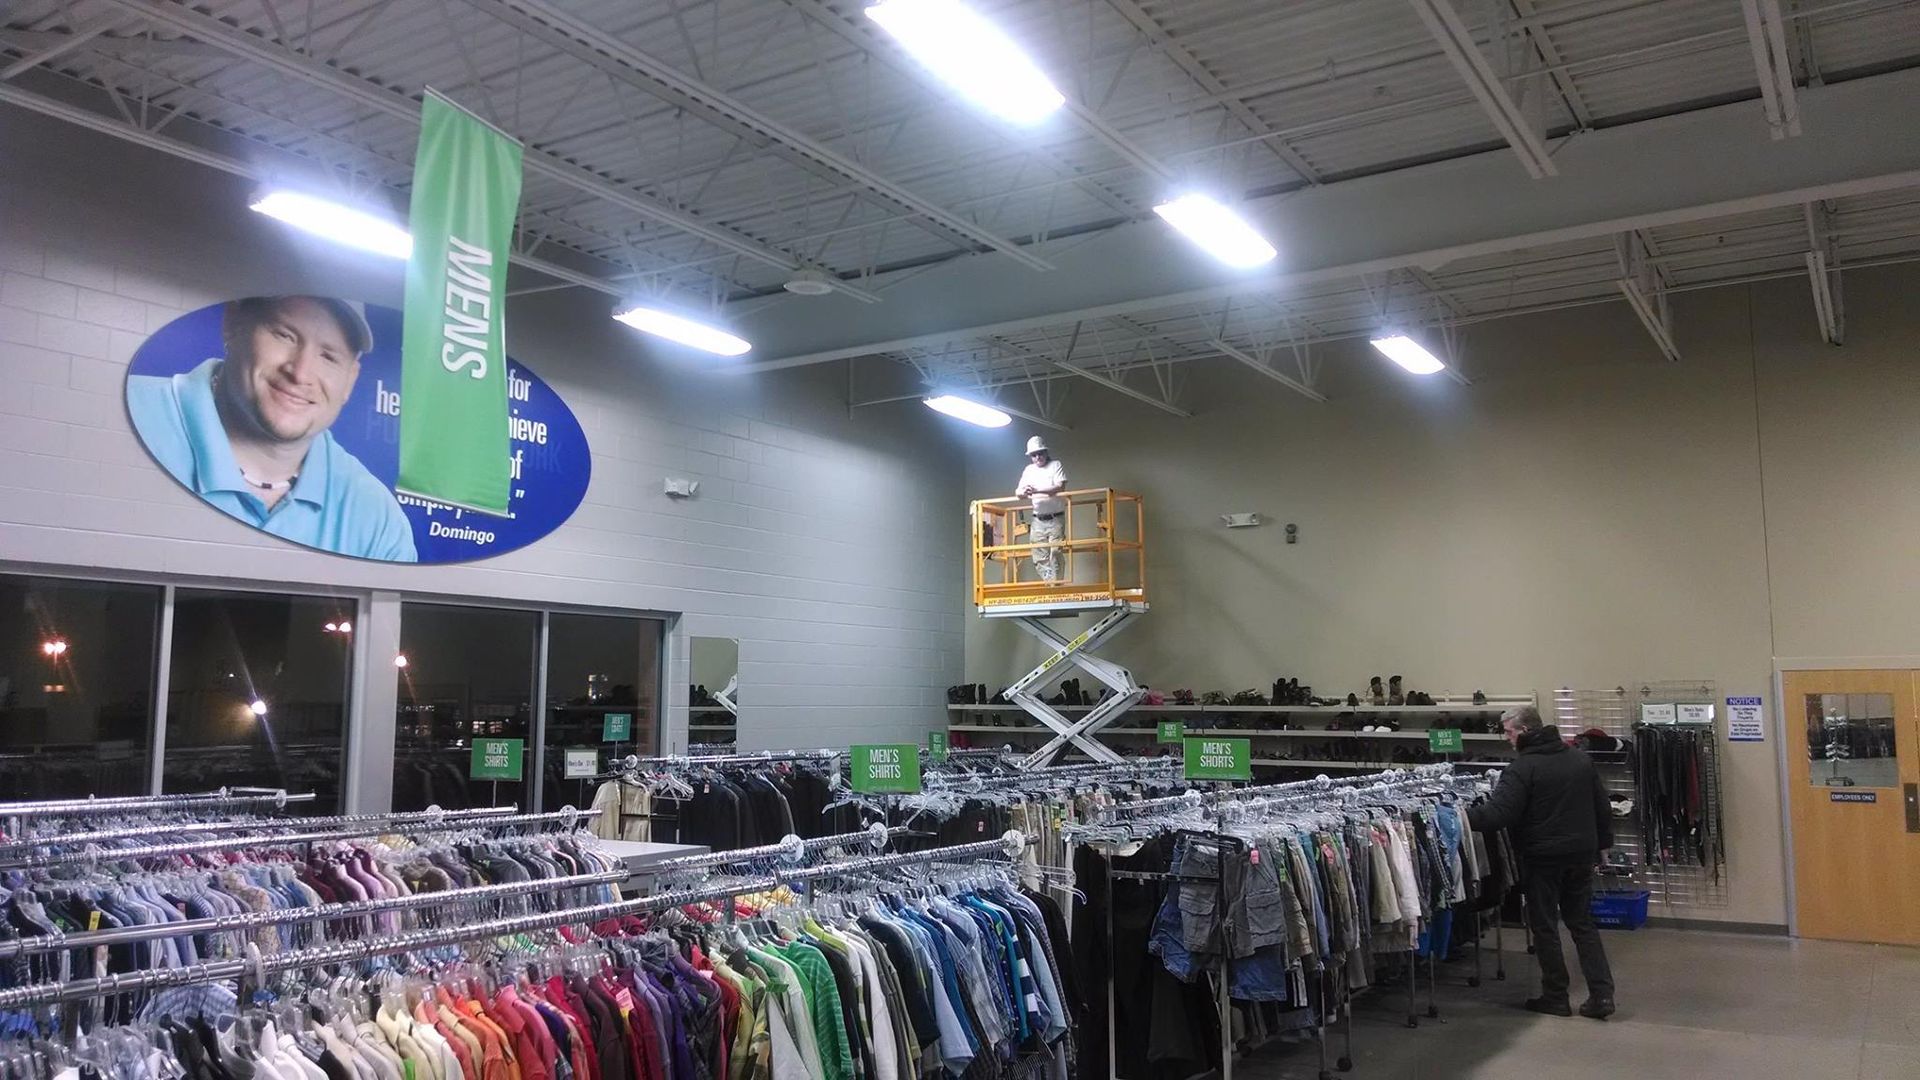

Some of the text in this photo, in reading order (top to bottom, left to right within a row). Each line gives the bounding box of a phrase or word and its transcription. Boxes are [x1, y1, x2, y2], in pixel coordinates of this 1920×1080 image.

[442, 235, 493, 380] MENS
[376, 380, 400, 417] he
[429, 522, 496, 545] Domingo
[1730, 697, 1758, 705] NOTICE
[486, 742, 509, 755] MEN'S
[1203, 742, 1231, 755] MEN'S
[484, 755, 509, 768] SHIRTS
[869, 749, 899, 763] MEN'S
[1200, 755, 1234, 768] SHORTS
[869, 764, 901, 779] SHIRTS
